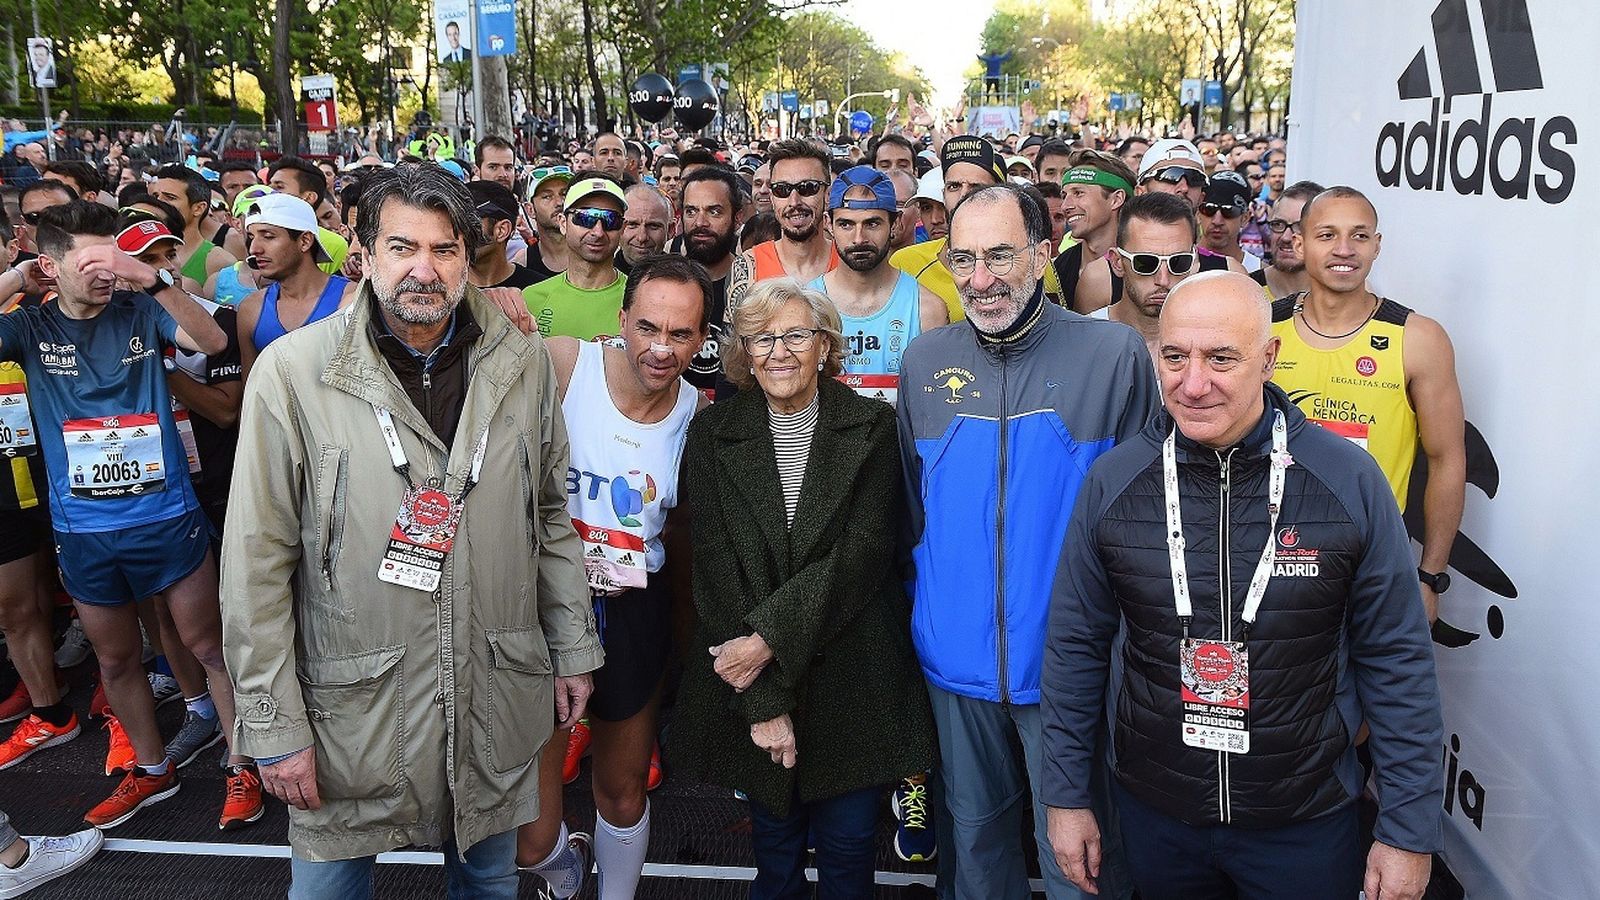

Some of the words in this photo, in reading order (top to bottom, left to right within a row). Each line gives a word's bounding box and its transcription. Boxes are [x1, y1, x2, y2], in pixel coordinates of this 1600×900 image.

[629, 90, 649, 103] 3:00
[317, 103, 328, 127] 1
[947, 140, 982, 151] RUNNING
[1375, 93, 1577, 205] adidas
[847, 330, 881, 355] rja
[934, 367, 975, 382] CANGURO
[1331, 376, 1400, 389] LEGALITAS.COM
[1314, 397, 1357, 411] CLÍNICA
[1313, 409, 1376, 424] MENORCA
[92, 460, 141, 484] 20063
[565, 466, 610, 500] BT
[589, 529, 609, 544] edp
[413, 546, 444, 559] ACCESO
[1185, 702, 1209, 713] LIBRE
[1209, 706, 1245, 718] ACCESO
[1443, 733, 1486, 832] ia
